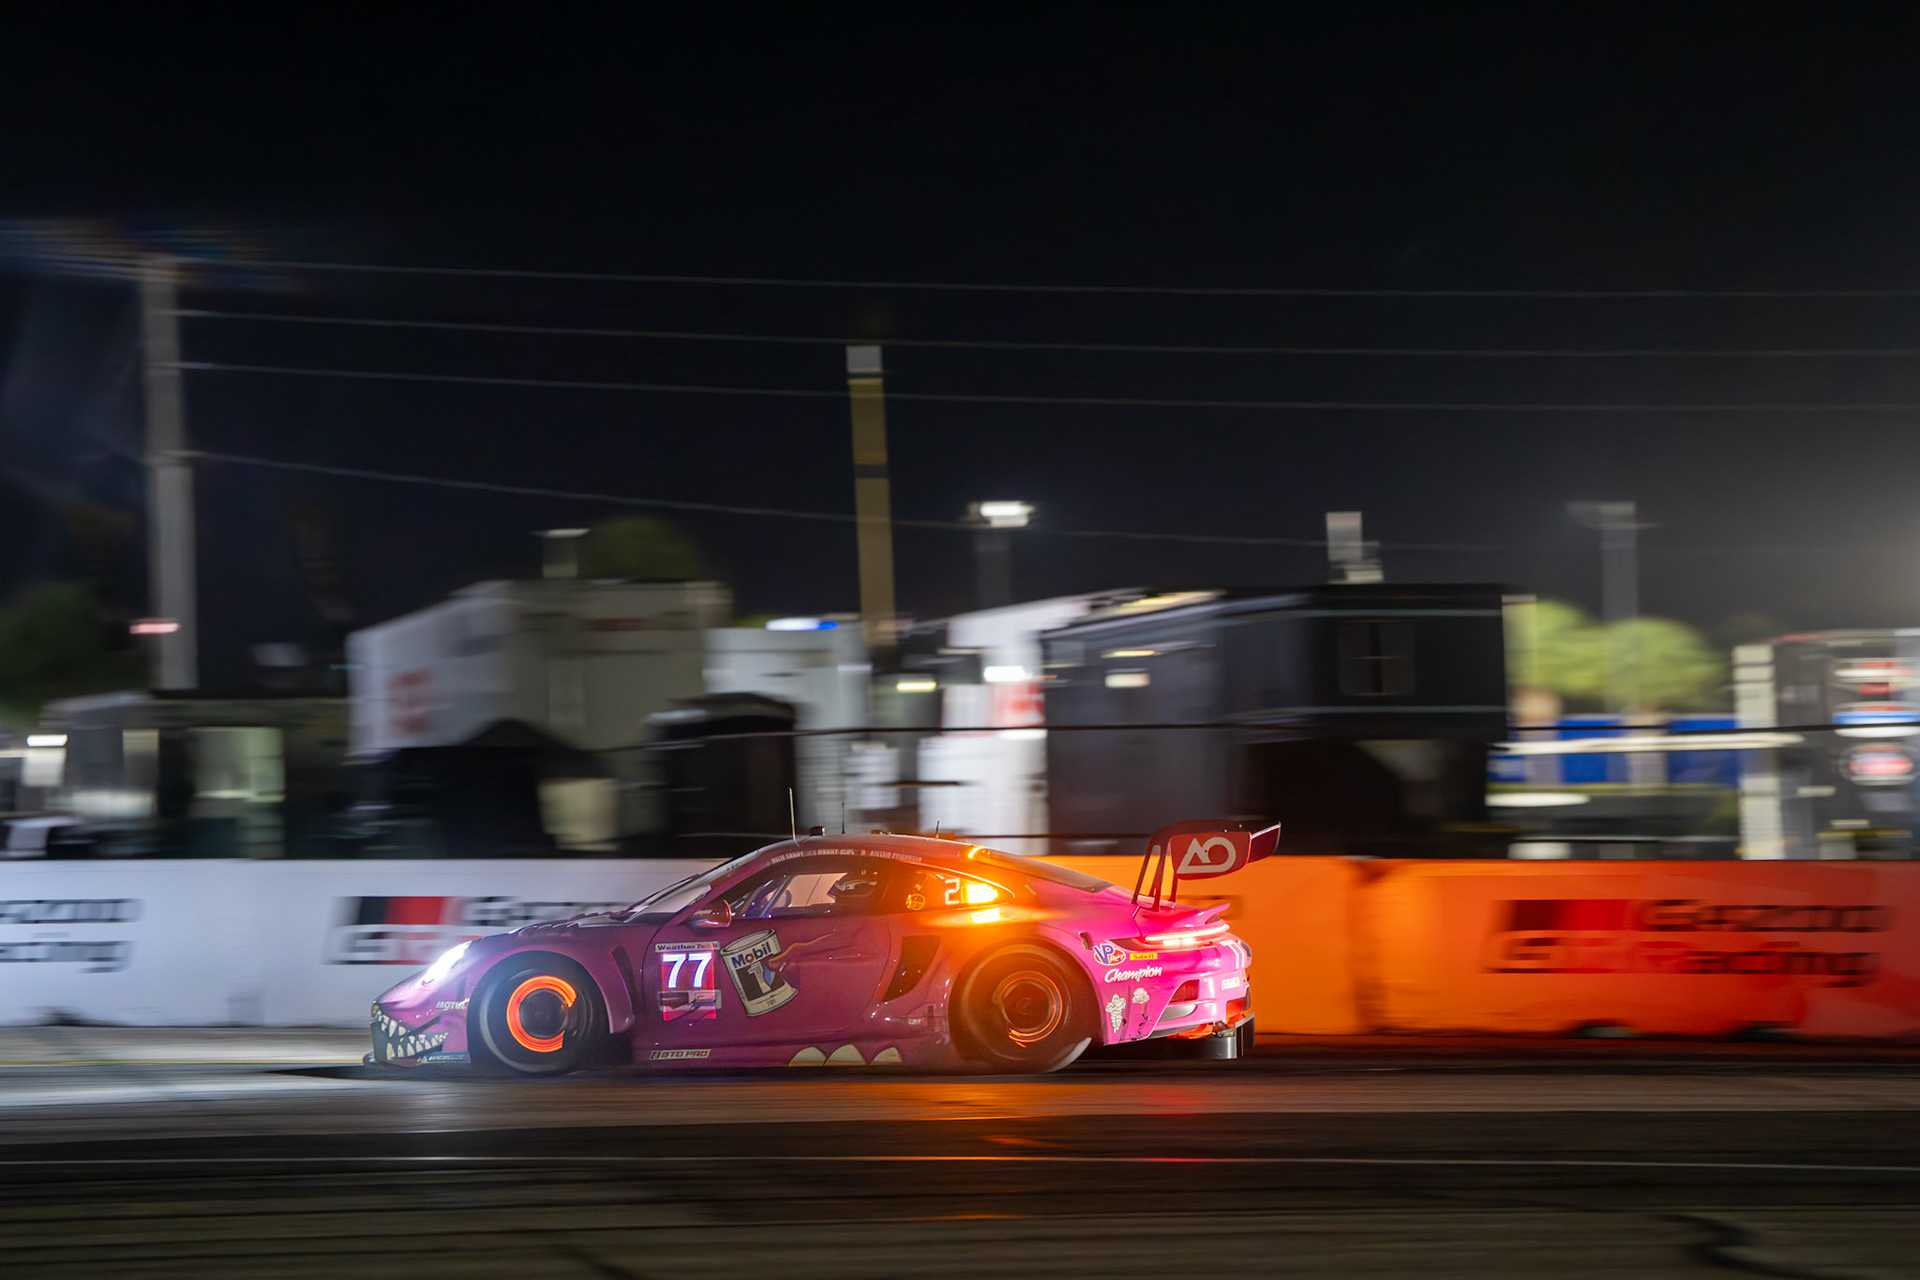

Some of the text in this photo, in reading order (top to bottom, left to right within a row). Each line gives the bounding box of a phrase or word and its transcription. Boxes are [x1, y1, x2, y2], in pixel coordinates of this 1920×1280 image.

[1176, 836, 1237, 875] AO
[945, 878, 961, 905] 2
[656, 943, 720, 951] WeatherTech
[731, 942, 772, 969] Mobil
[1093, 944, 1115, 965] VP
[662, 952, 713, 989] 77
[747, 961, 772, 994] 1
[1104, 965, 1162, 983] Champion
